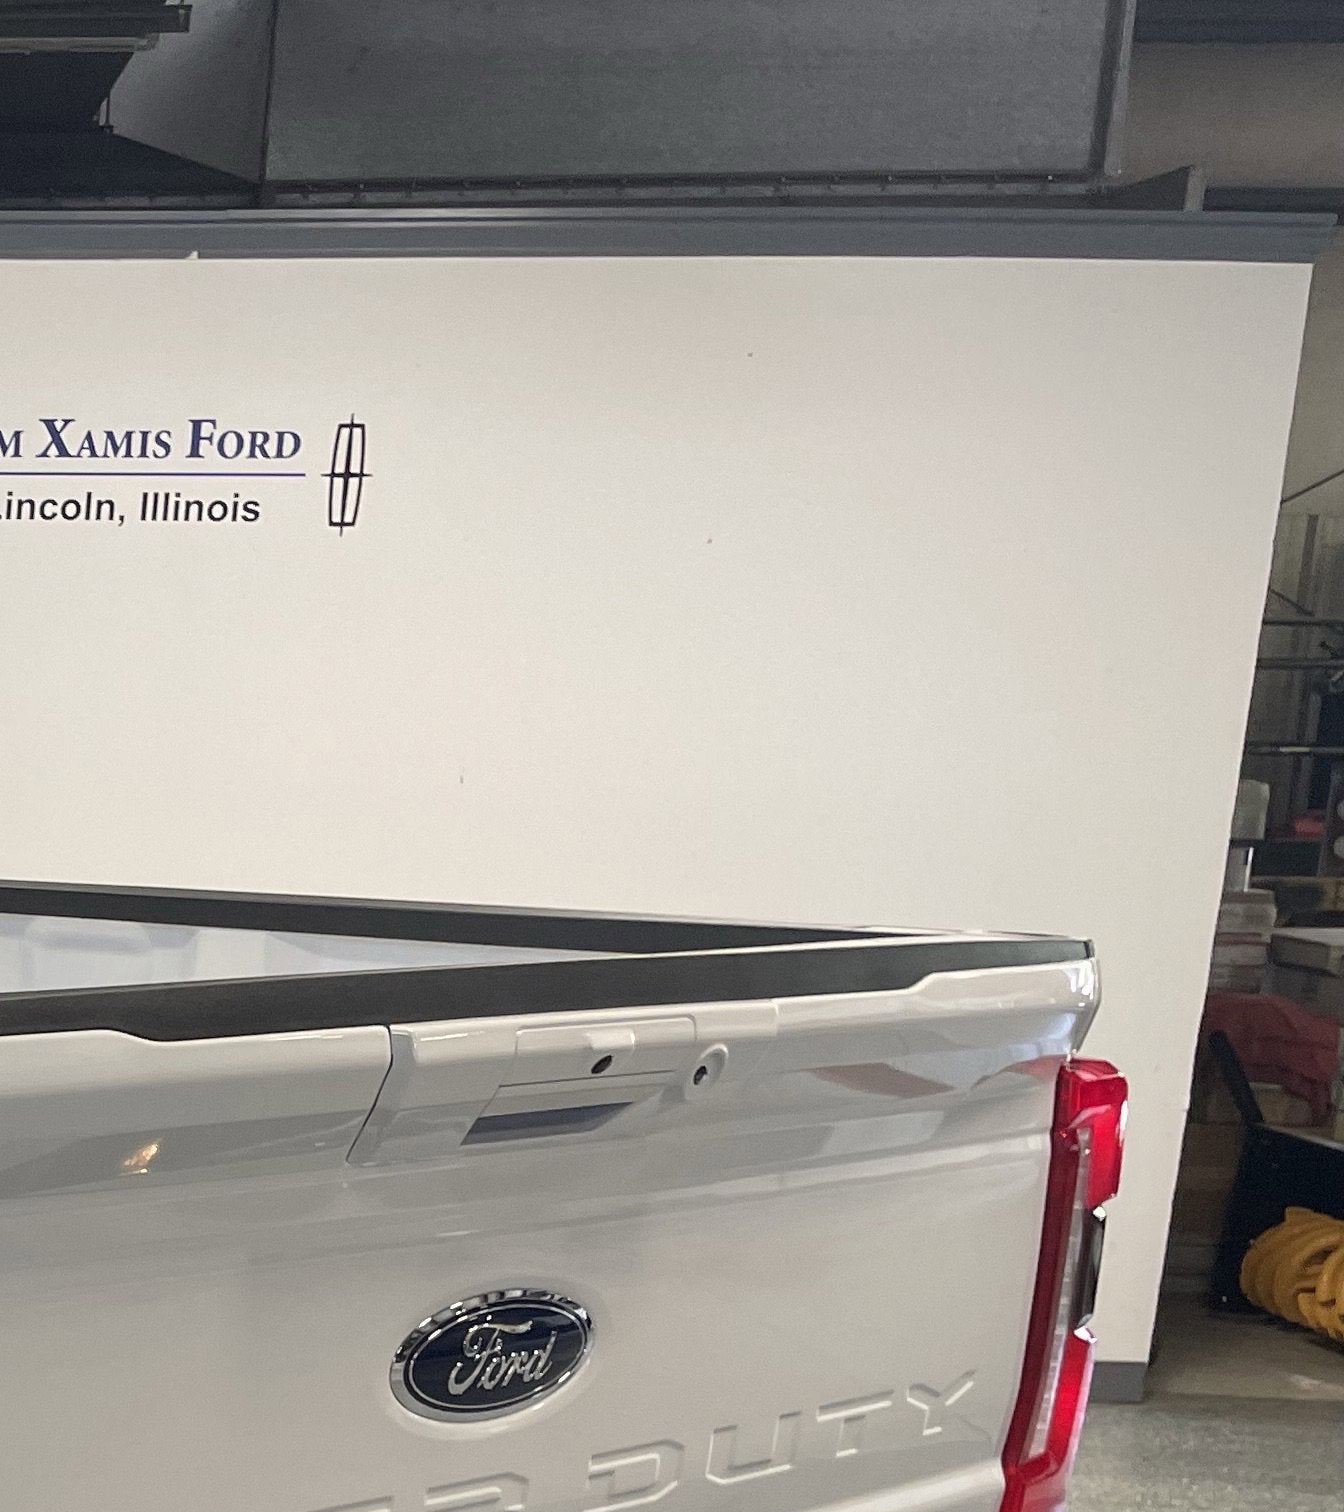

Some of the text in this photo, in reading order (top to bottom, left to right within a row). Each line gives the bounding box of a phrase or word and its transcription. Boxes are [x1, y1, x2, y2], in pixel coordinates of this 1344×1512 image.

[35, 418, 173, 460] XAMIS
[185, 418, 302, 461] FORD
[139, 492, 261, 524] Illinois
[447, 1319, 559, 1396] Ford
